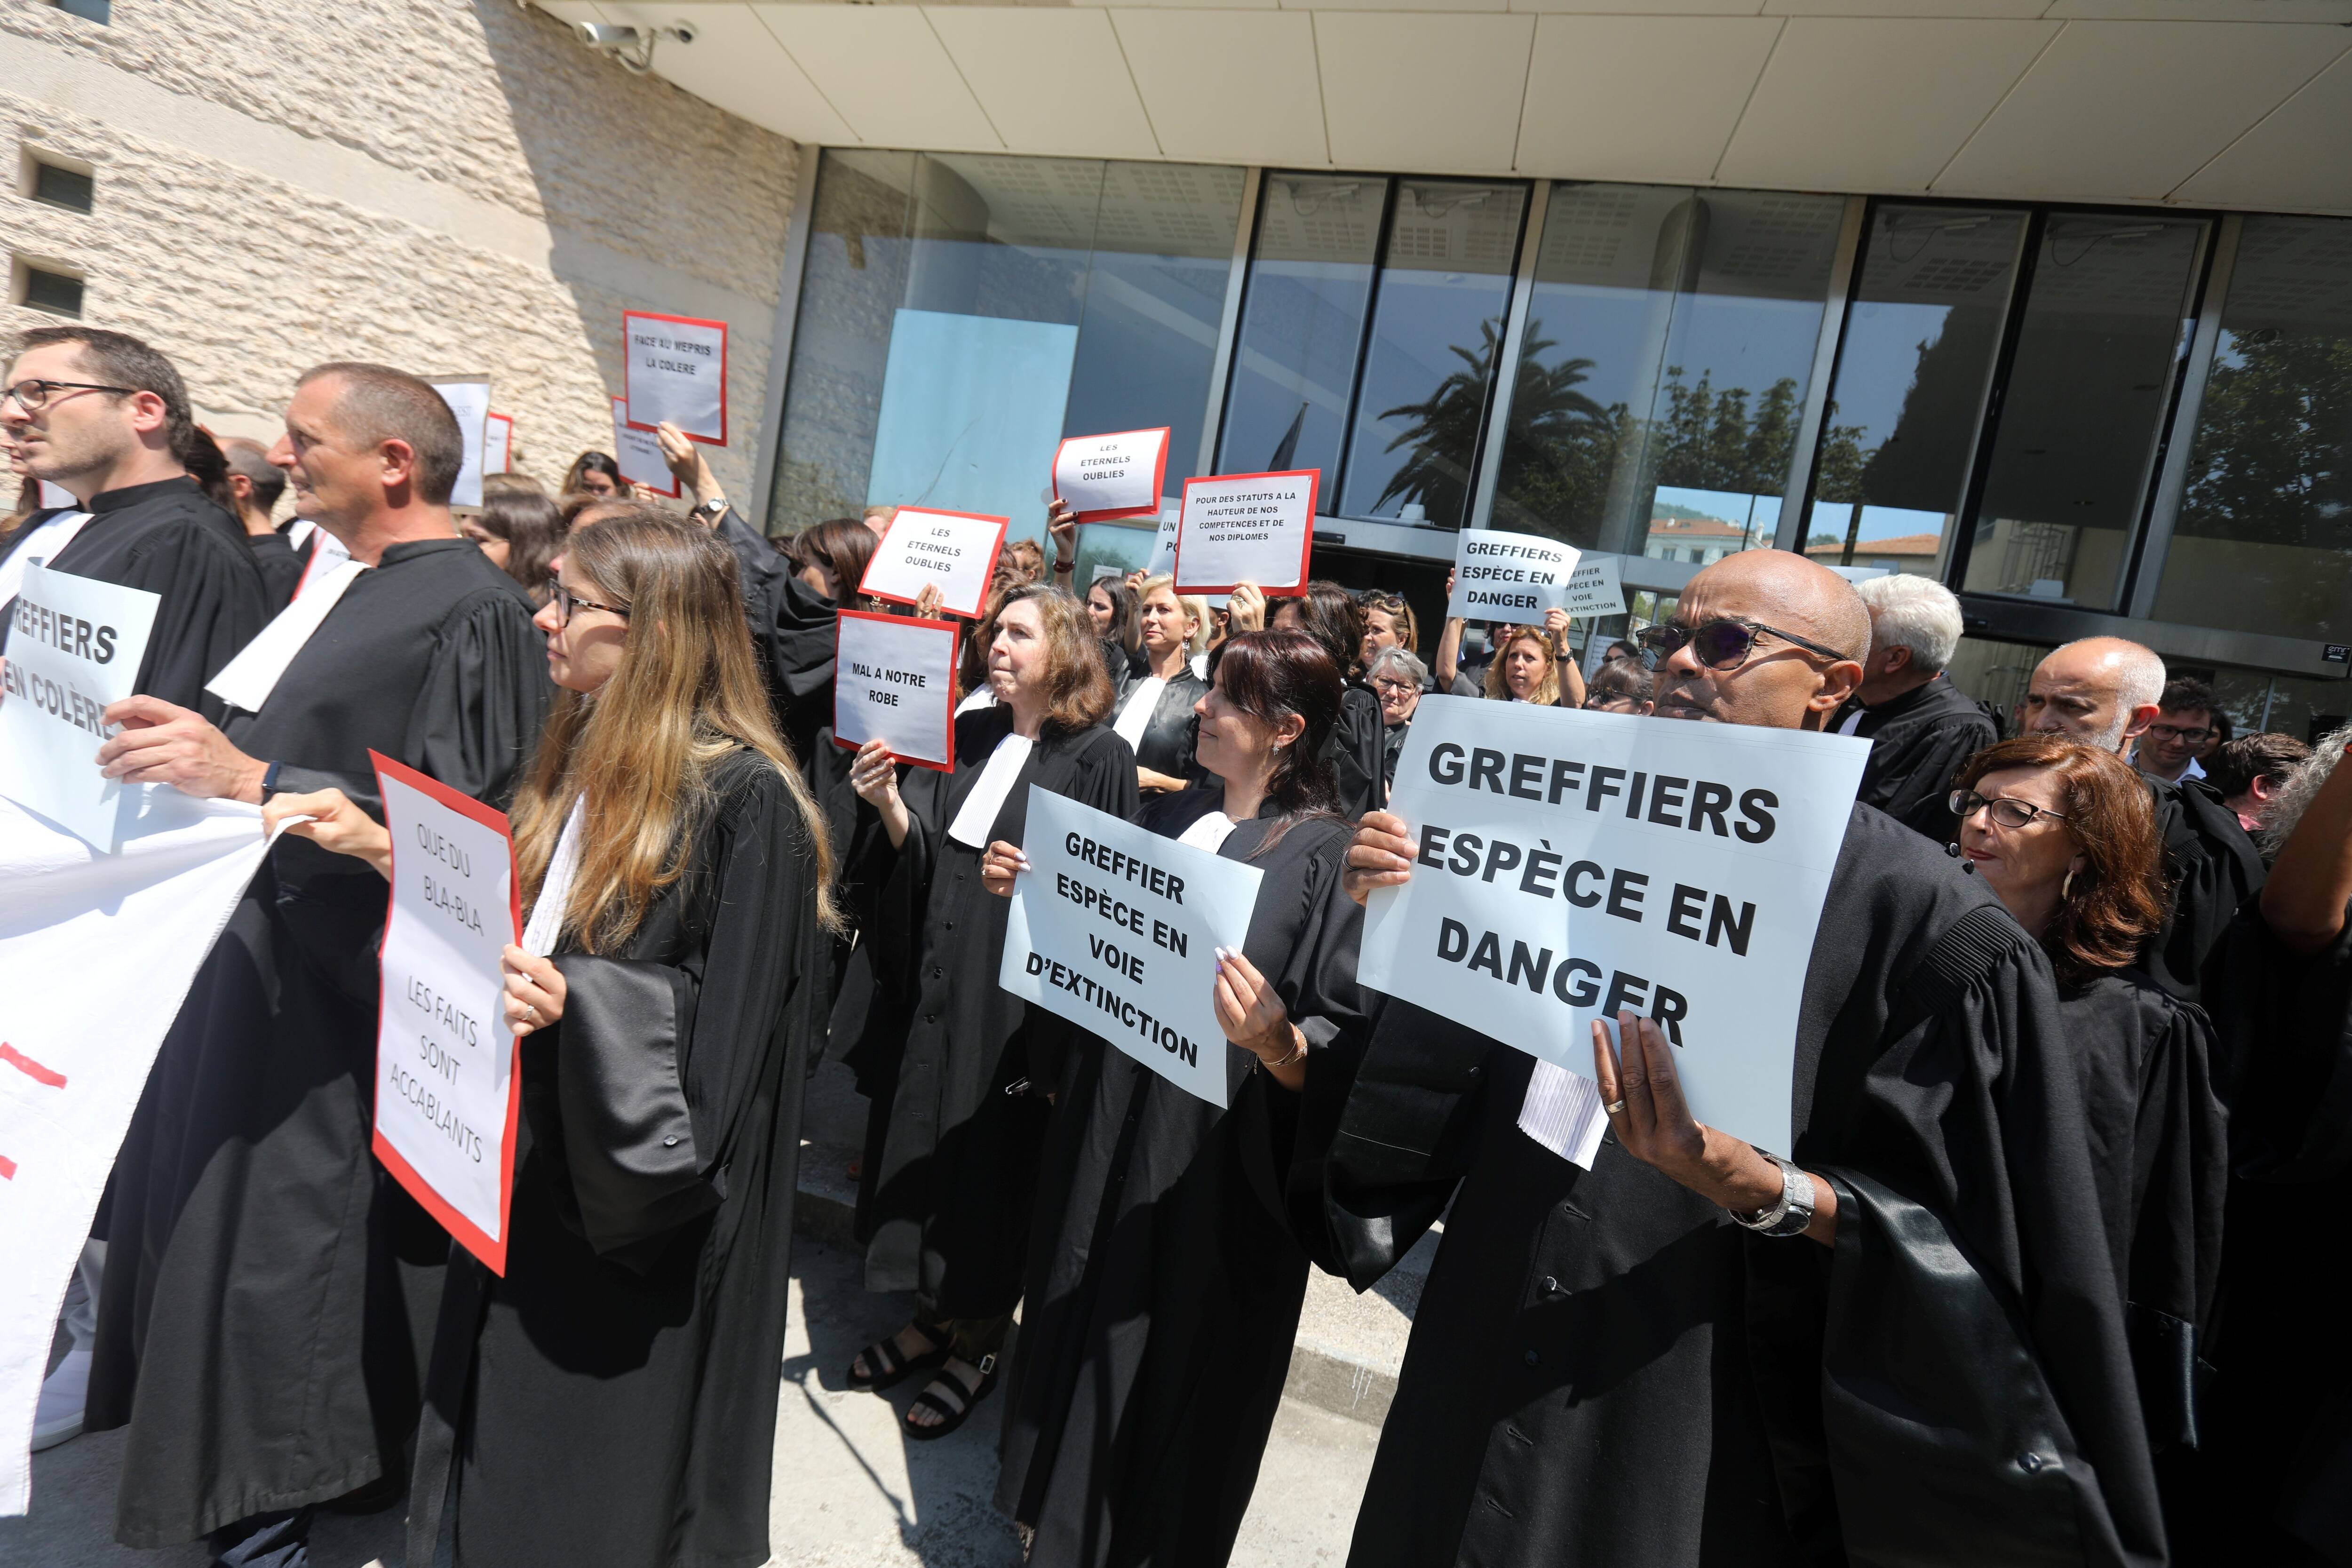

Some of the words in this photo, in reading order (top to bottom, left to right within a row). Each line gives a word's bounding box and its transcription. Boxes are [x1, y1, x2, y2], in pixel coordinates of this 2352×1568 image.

[635, 335, 655, 347] FACE
[659, 338, 671, 350] AU
[674, 341, 711, 356] MEPRIS
[646, 357, 655, 367] LA
[659, 360, 696, 374] COLERE
[1100, 444, 1118, 452] LES
[1080, 455, 1130, 467] ETERNELS
[1083, 469, 1125, 480] OUBLIES
[930, 527, 951, 538] LES
[1163, 522, 1176, 532] UN
[1199, 520, 1257, 529] COMPETENCES
[907, 541, 961, 557] ETERNELS
[1466, 542, 1563, 563] GREFFIERS
[905, 556, 951, 572] OUBLIES
[1571, 567, 1600, 577] EFFIER
[1462, 565, 1524, 582] ESPÈCE
[1529, 571, 1555, 585] EN
[1566, 581, 1590, 590] SPÈCE
[1467, 591, 1538, 609] DANGER
[13, 598, 118, 664] REFFIERS
[4, 660, 28, 700] EN
[852, 663, 871, 677] MAL
[875, 668, 882, 679] A
[885, 669, 926, 688] NOTRE
[869, 690, 898, 707] ROBE
[1429, 742, 1780, 844] GREFFIERS
[417, 822, 448, 865] QUE
[449, 843, 471, 878] DU
[1065, 832, 1184, 905] GREFFIER
[1417, 824, 1650, 923] ESPÈCE
[1667, 882, 1756, 957] EN
[424, 875, 485, 936] BLA-BLA
[1057, 873, 1144, 936] ESPÈCE
[1153, 919, 1188, 958] EN
[1089, 933, 1144, 984] VOIE
[1437, 916, 1688, 1048] DANGER
[407, 974, 431, 1013] LES
[435, 996, 477, 1048] FAITS
[1025, 951, 1198, 1068] D'EXTINCTION
[419, 1034, 461, 1086] SONT
[389, 1062, 483, 1165] ACCABLANTS
